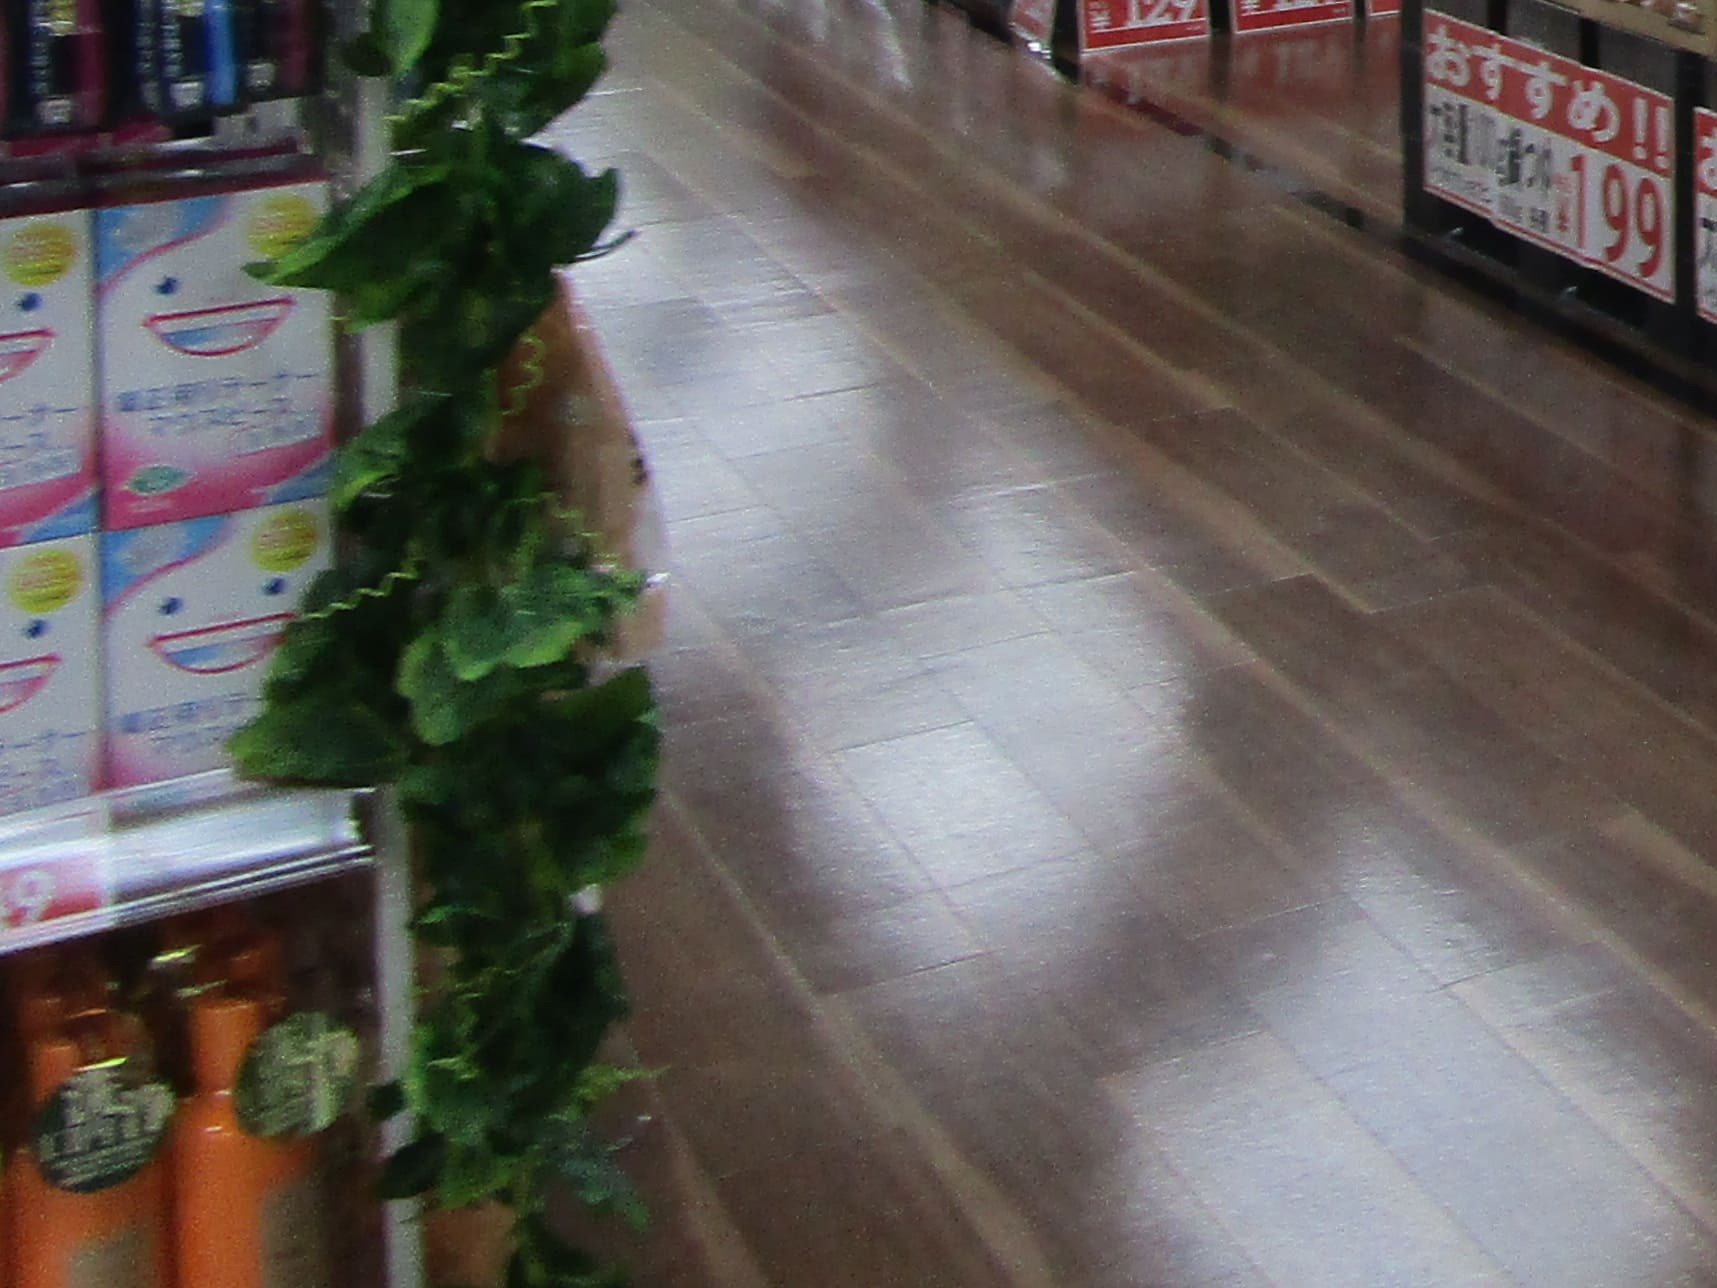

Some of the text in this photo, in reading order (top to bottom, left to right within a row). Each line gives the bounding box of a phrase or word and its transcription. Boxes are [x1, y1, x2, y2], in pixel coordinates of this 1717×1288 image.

[1425, 25, 1673, 169] おすすめ!!
[1571, 151, 1665, 278] 199
